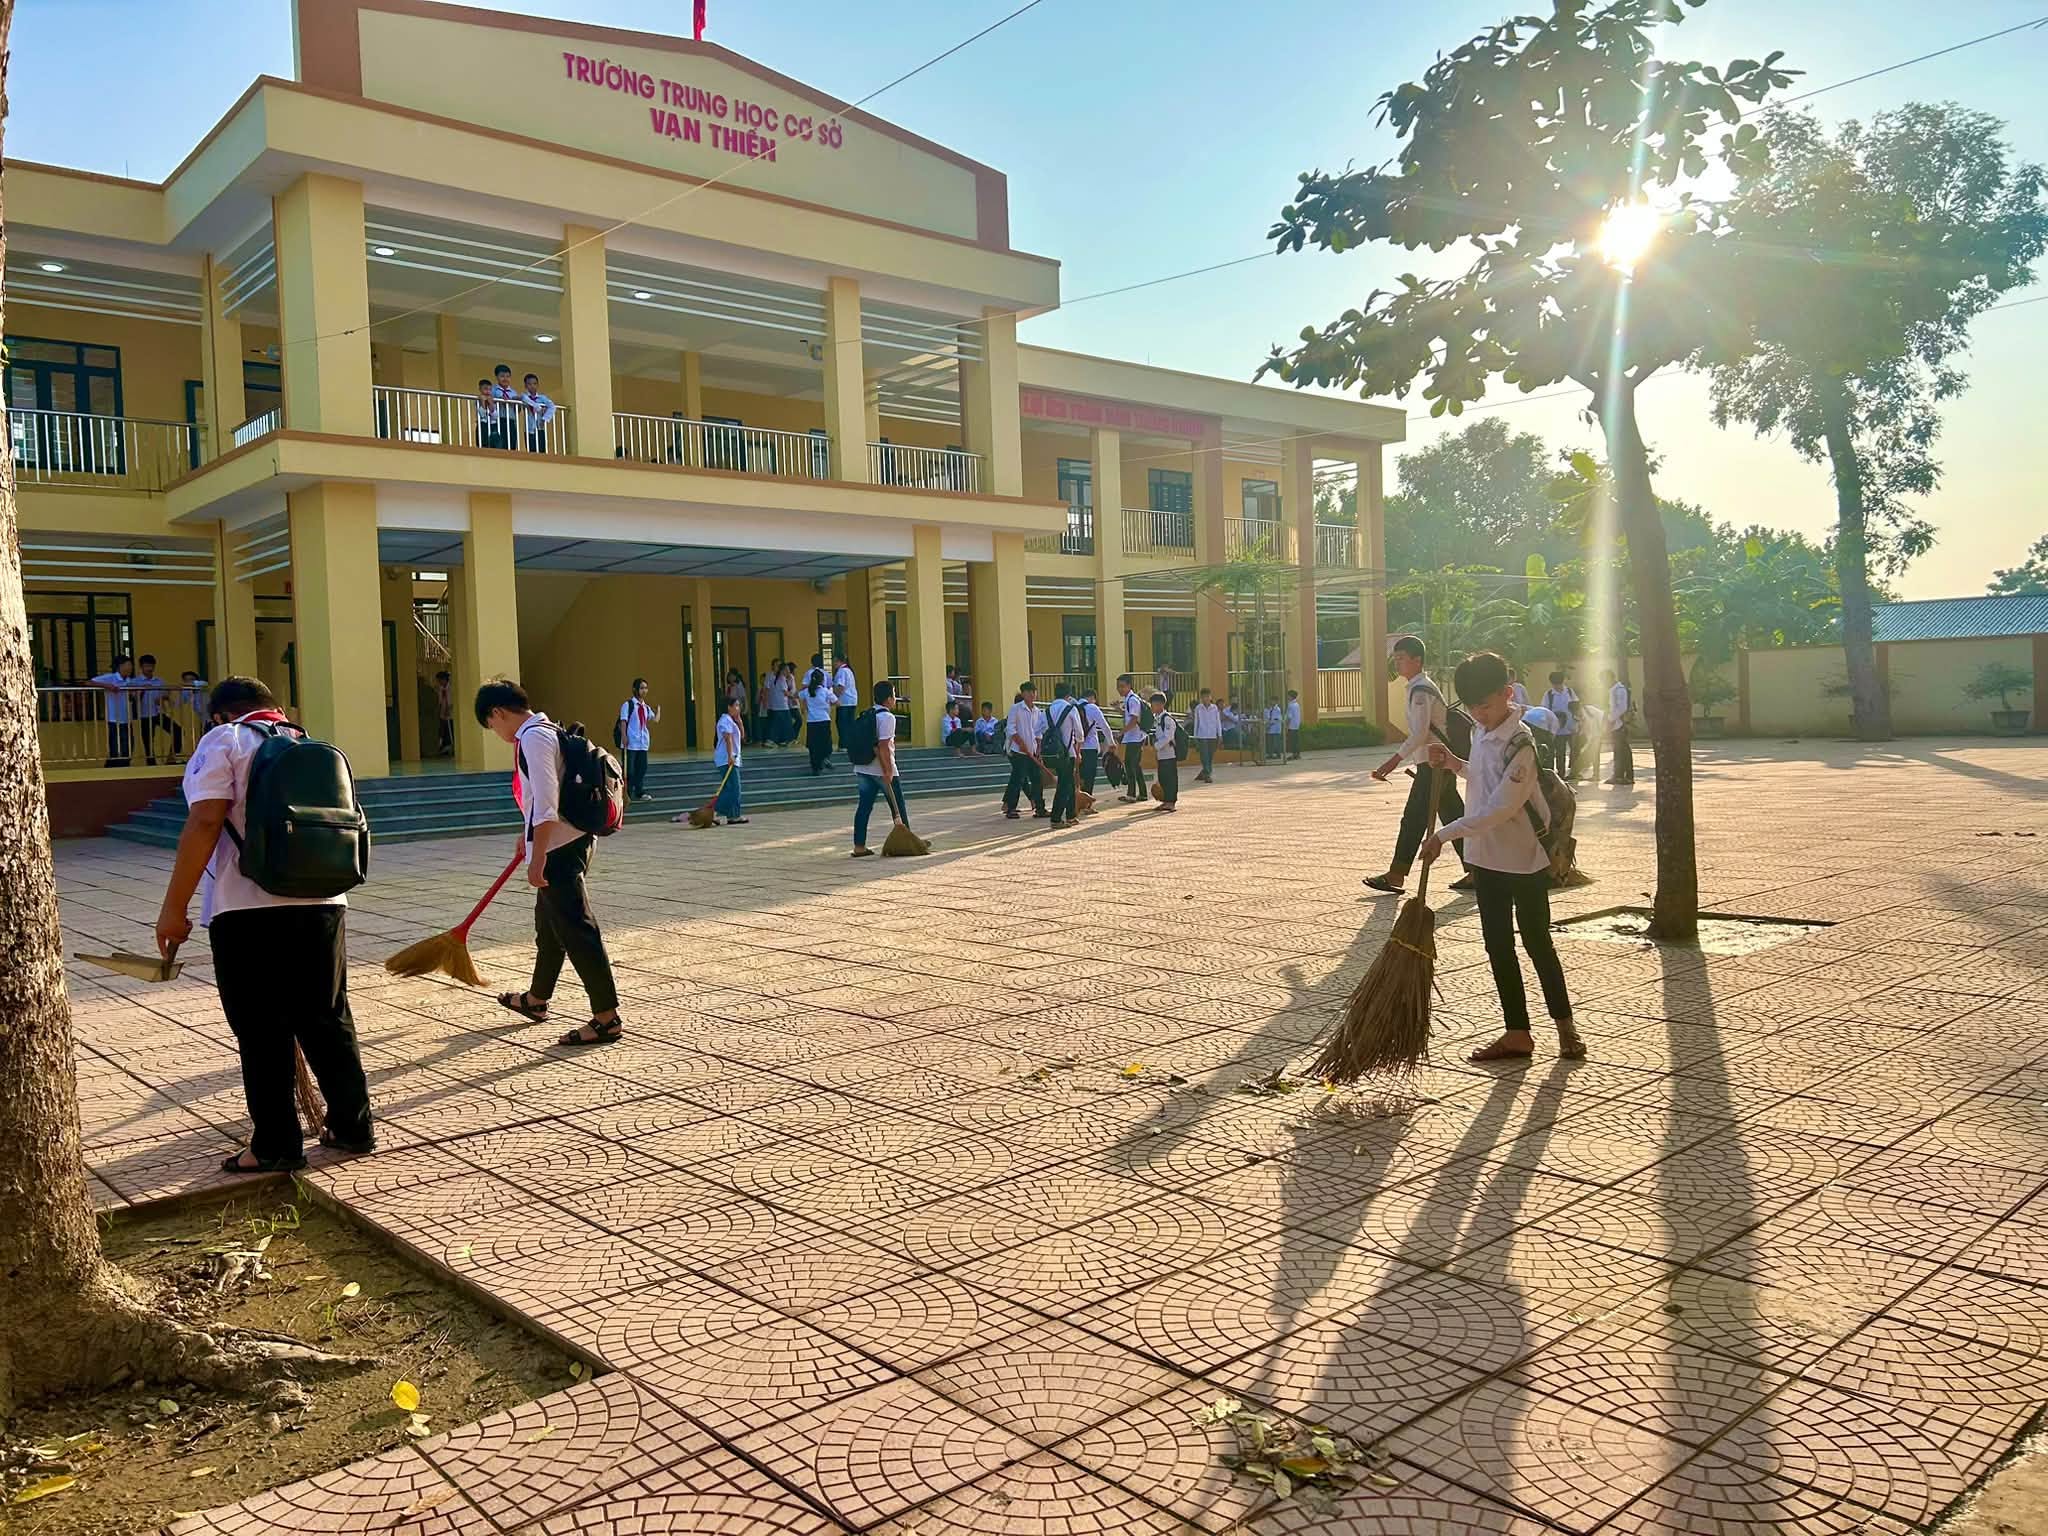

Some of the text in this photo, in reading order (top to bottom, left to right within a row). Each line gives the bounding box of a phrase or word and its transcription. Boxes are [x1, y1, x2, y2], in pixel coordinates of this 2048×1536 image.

[563, 53, 842, 149] TRƯỜNG TRUNG HỌC CƠ SỞ
[649, 107, 701, 144] VẠN
